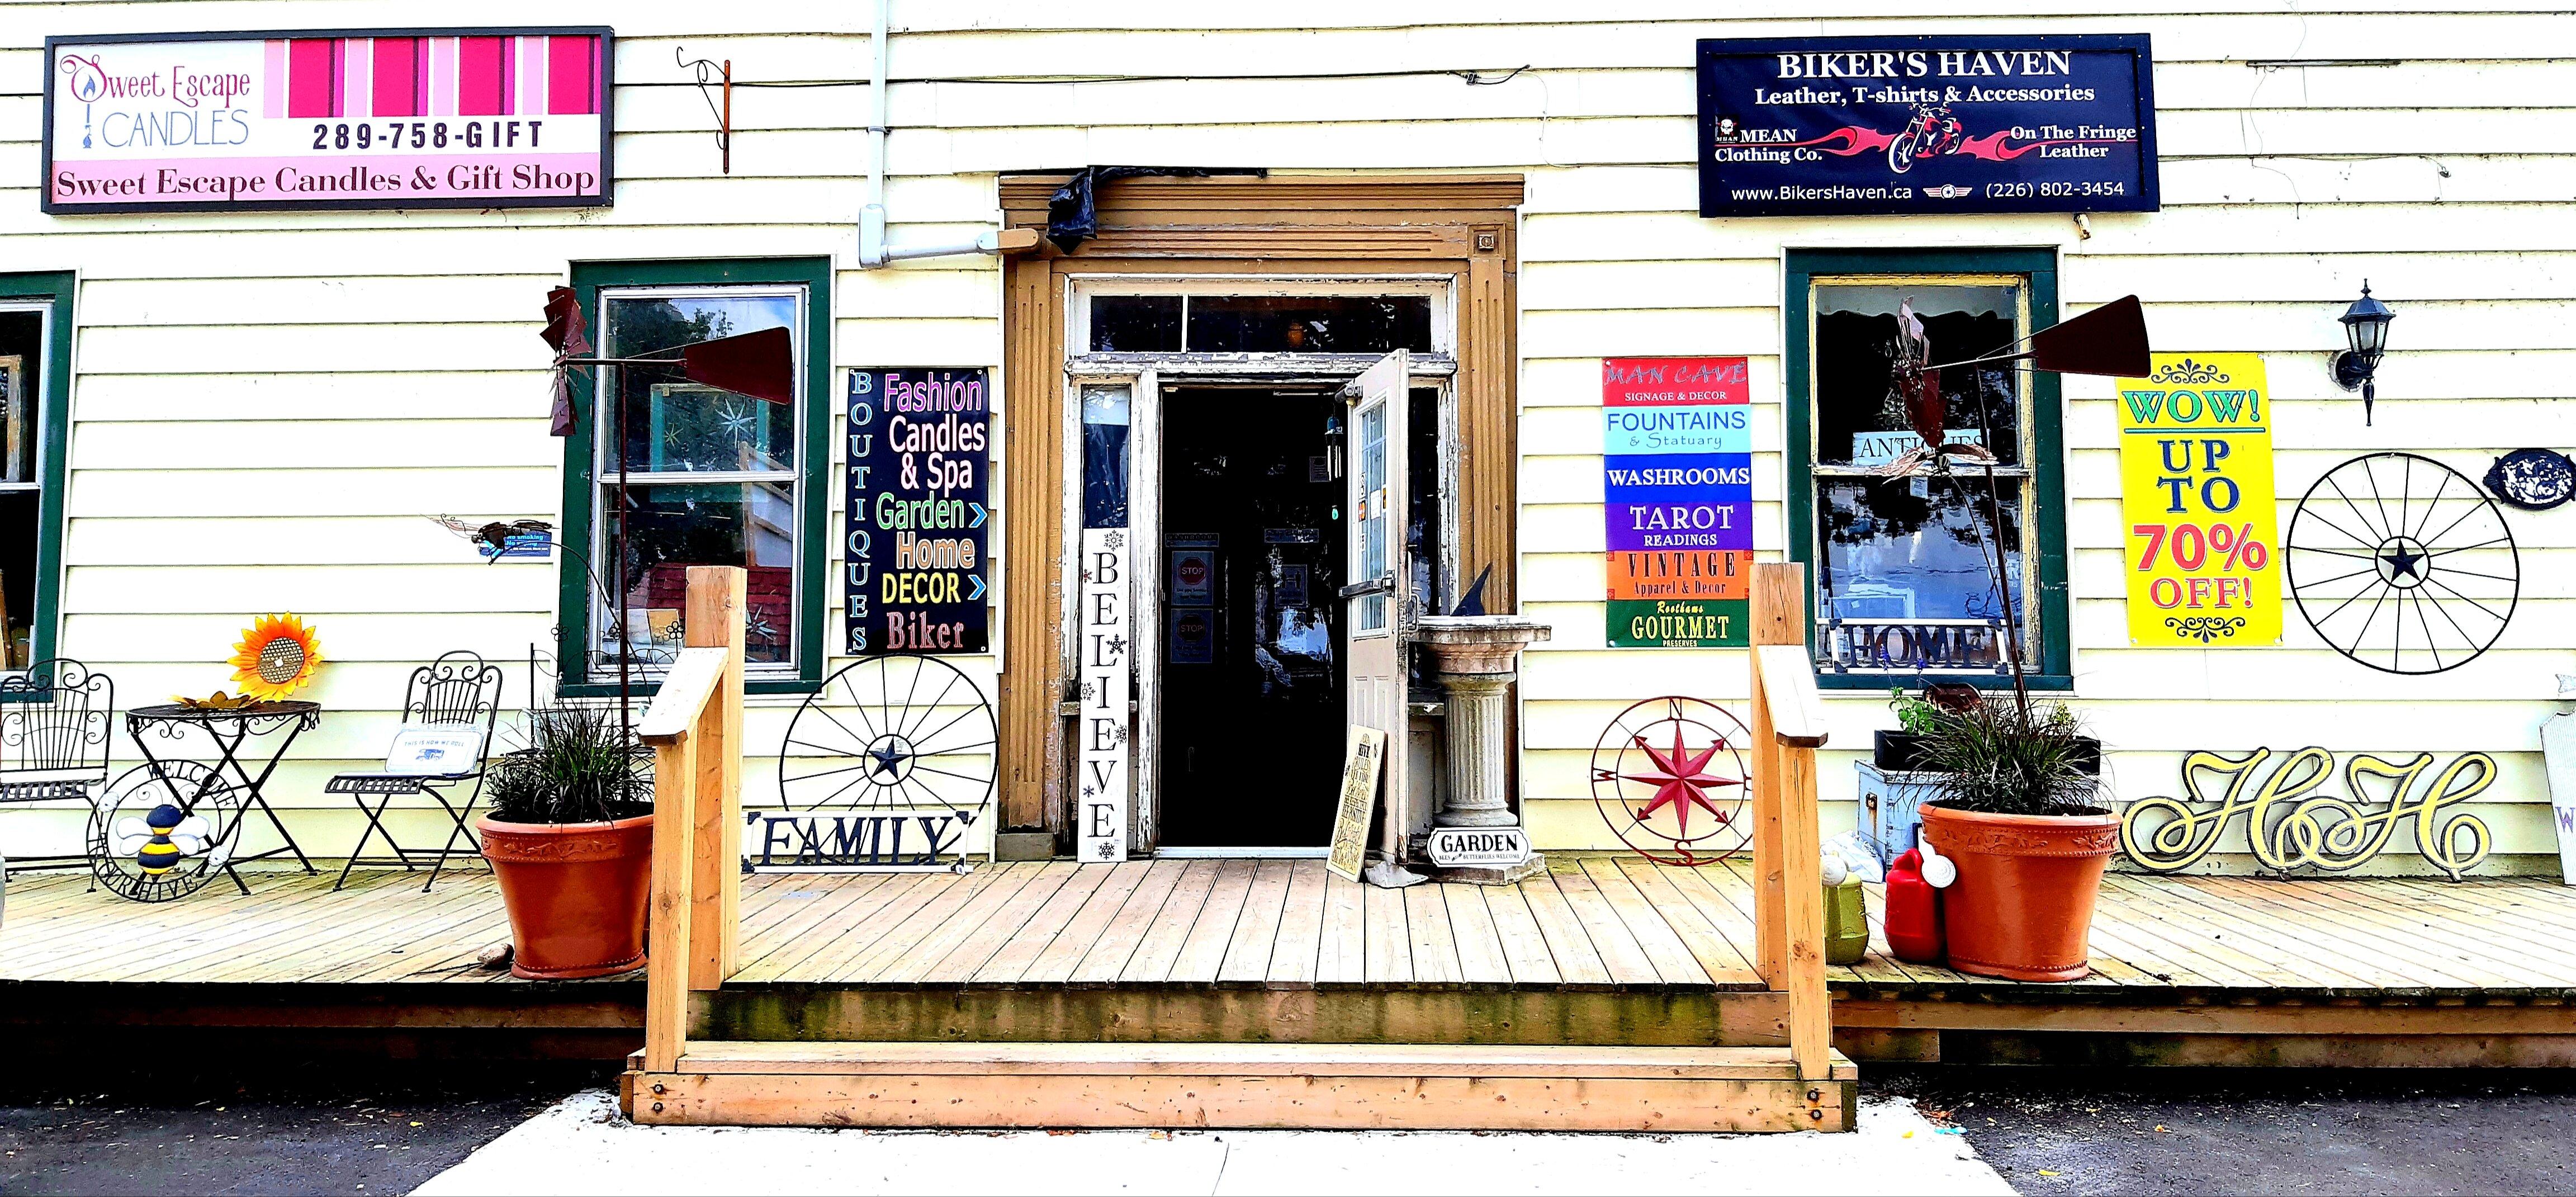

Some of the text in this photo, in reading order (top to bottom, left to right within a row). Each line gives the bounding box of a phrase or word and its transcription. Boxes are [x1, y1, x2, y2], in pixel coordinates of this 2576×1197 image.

[1777, 51, 2072, 78] BIKER'S HAVEN
[60, 54, 250, 108] Sweet Escape
[1755, 84, 2095, 106] Leather, T-shirts & Accessories
[102, 110, 249, 147] CANDLES
[313, 121, 542, 149] 289-758-GIFT
[1740, 129, 1797, 143] MEAN
[2011, 125, 2137, 141] On The Fringe
[1715, 148, 1822, 163] Clothing Co.
[2039, 144, 2109, 158] Leather
[57, 164, 594, 201] Sweet Escape Candles & Gift Shop
[1732, 186, 1912, 201] www.BikersHaven.ca
[1986, 182, 2124, 198] (226) 802-3454
[1604, 363, 1748, 386] MAN CAVE
[884, 372, 982, 412] Fashion
[1625, 391, 1727, 401] SIGNAGE & DECOR
[2122, 389, 2261, 423] WOW!
[889, 414, 986, 452] Candles
[1608, 411, 1746, 432] FOUNTAINS
[1630, 432, 1722, 449] & Statuary
[2157, 439, 2231, 474] UP
[901, 452, 972, 497] & Spa
[1607, 467, 1750, 486] WASHROOMS
[2156, 475, 2241, 513] TO
[849, 372, 873, 651] BOUTIQUES
[877, 491, 964, 529] Garden
[1630, 505, 1734, 531] TAROT
[897, 532, 975, 570] Home
[1644, 534, 1717, 546] READINGS
[2133, 523, 2269, 571] 70%
[1181, 566, 1204, 575] STOP
[1628, 552, 1735, 578] VINTAGE
[882, 573, 961, 604] DECOR
[1634, 580, 1726, 597] Apparel & Decor
[2150, 576, 2253, 608] OFF!
[887, 611, 964, 650] Biker
[1631, 616, 1729, 639] GOURMET
[1839, 624, 1993, 669] HOME
[1087, 551, 1119, 838] BELIEVE
[761, 816, 953, 866] FAMILY
[1440, 834, 1518, 853] GARDEN
